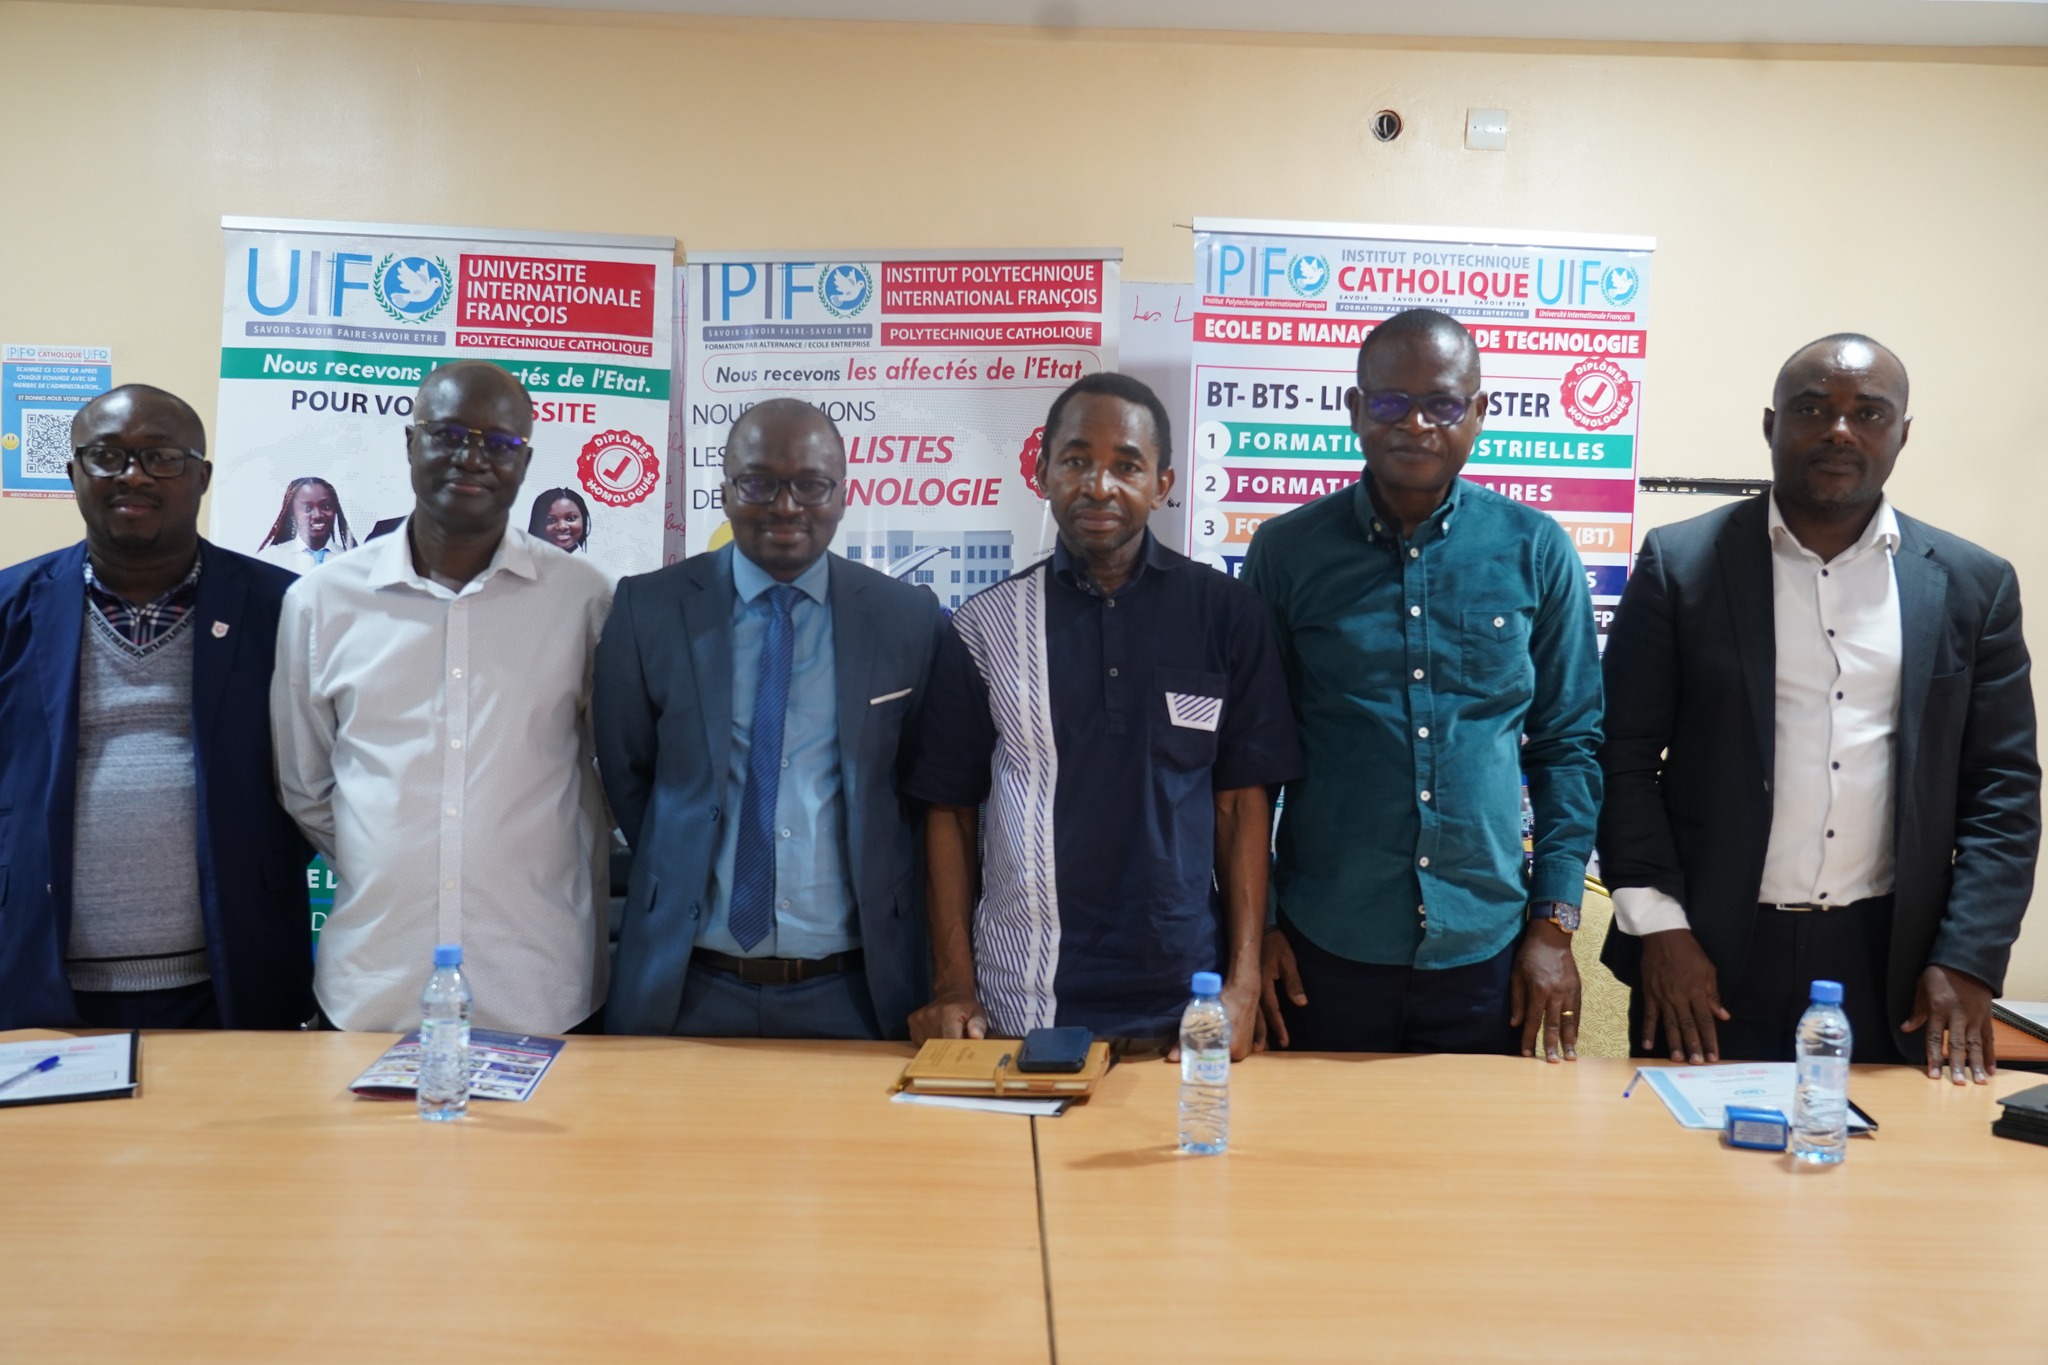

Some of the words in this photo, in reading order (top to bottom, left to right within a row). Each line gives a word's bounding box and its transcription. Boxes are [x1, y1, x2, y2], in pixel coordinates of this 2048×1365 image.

[468, 259, 587, 283] UNIVERSITE
[1342, 250, 1406, 264] INSTITUT
[1413, 252, 1530, 270] POLYTECHNIQUE
[886, 267, 958, 283] INSTITUT
[962, 265, 1094, 283] POLYTECHNIQUE
[1338, 266, 1529, 300] CATHOLIQUE
[466, 281, 642, 308] INTERNATIONALE
[886, 290, 1014, 306] INTERNATIONAL
[1018, 288, 1098, 308] FRANÇOIS
[1205, 297, 1224, 305] Institut
[1226, 298, 1264, 308] Polytechnique
[1265, 300, 1302, 308] International
[1302, 301, 1326, 310] Français
[466, 302, 568, 328] FRANÇOIS
[1340, 304, 1384, 312] FORMATION
[1458, 308, 1480, 316] ECOLE
[1482, 309, 1524, 318] ENTREPRISE
[1538, 310, 1567, 318] Université
[1568, 311, 1606, 320] Internationale
[1606, 312, 1630, 322] Français
[254, 325, 333, 336] SAVOIR-SAVOIR
[338, 328, 410, 341] FAIRE-SAVOIR
[414, 334, 439, 343] ETRE
[460, 334, 566, 350] POLYTECHNIQUE
[568, 340, 649, 354] CATHOLIQUE
[708, 328, 776, 338] SAVOIR-SAVOIR
[780, 328, 842, 336] FAIRE-SAVOIR
[846, 327, 867, 335] ETRE
[890, 328, 1003, 342] POLYTECHNIQUE
[1006, 326, 1092, 340] CATHOLIQUE
[1205, 318, 1262, 340] ECOLE
[1268, 322, 1292, 342] DE
[1475, 330, 1500, 349] DE
[1504, 330, 1640, 354] TECHNOLOGIE
[705, 343, 744, 351] FORMATION
[263, 354, 318, 375] Nous
[324, 360, 422, 381] recevons
[557, 367, 585, 388] de
[716, 366, 758, 384] Nous
[764, 368, 840, 382] recevons
[847, 358, 877, 381] les
[886, 357, 978, 380] affectés
[986, 357, 1016, 380] de
[1575, 361, 1626, 385] DIPLÔMES
[291, 390, 368, 415] POUR
[820, 401, 876, 422] ONS
[1252, 383, 1299, 410] BTS
[1484, 392, 1550, 418] STER
[1568, 396, 1630, 428] HOMOLOGUÉS
[594, 432, 652, 460] DIPLÔMES
[842, 436, 955, 464] LISTES
[1208, 433, 1216, 450] 1
[1472, 439, 1605, 460] STRIELLES
[586, 471, 656, 504] HOMOLOGUÉS
[844, 478, 1002, 506] NOLOGIE
[1204, 476, 1216, 492] 2
[1204, 520, 1215, 536] 3
[1575, 527, 1615, 548] (BT)
